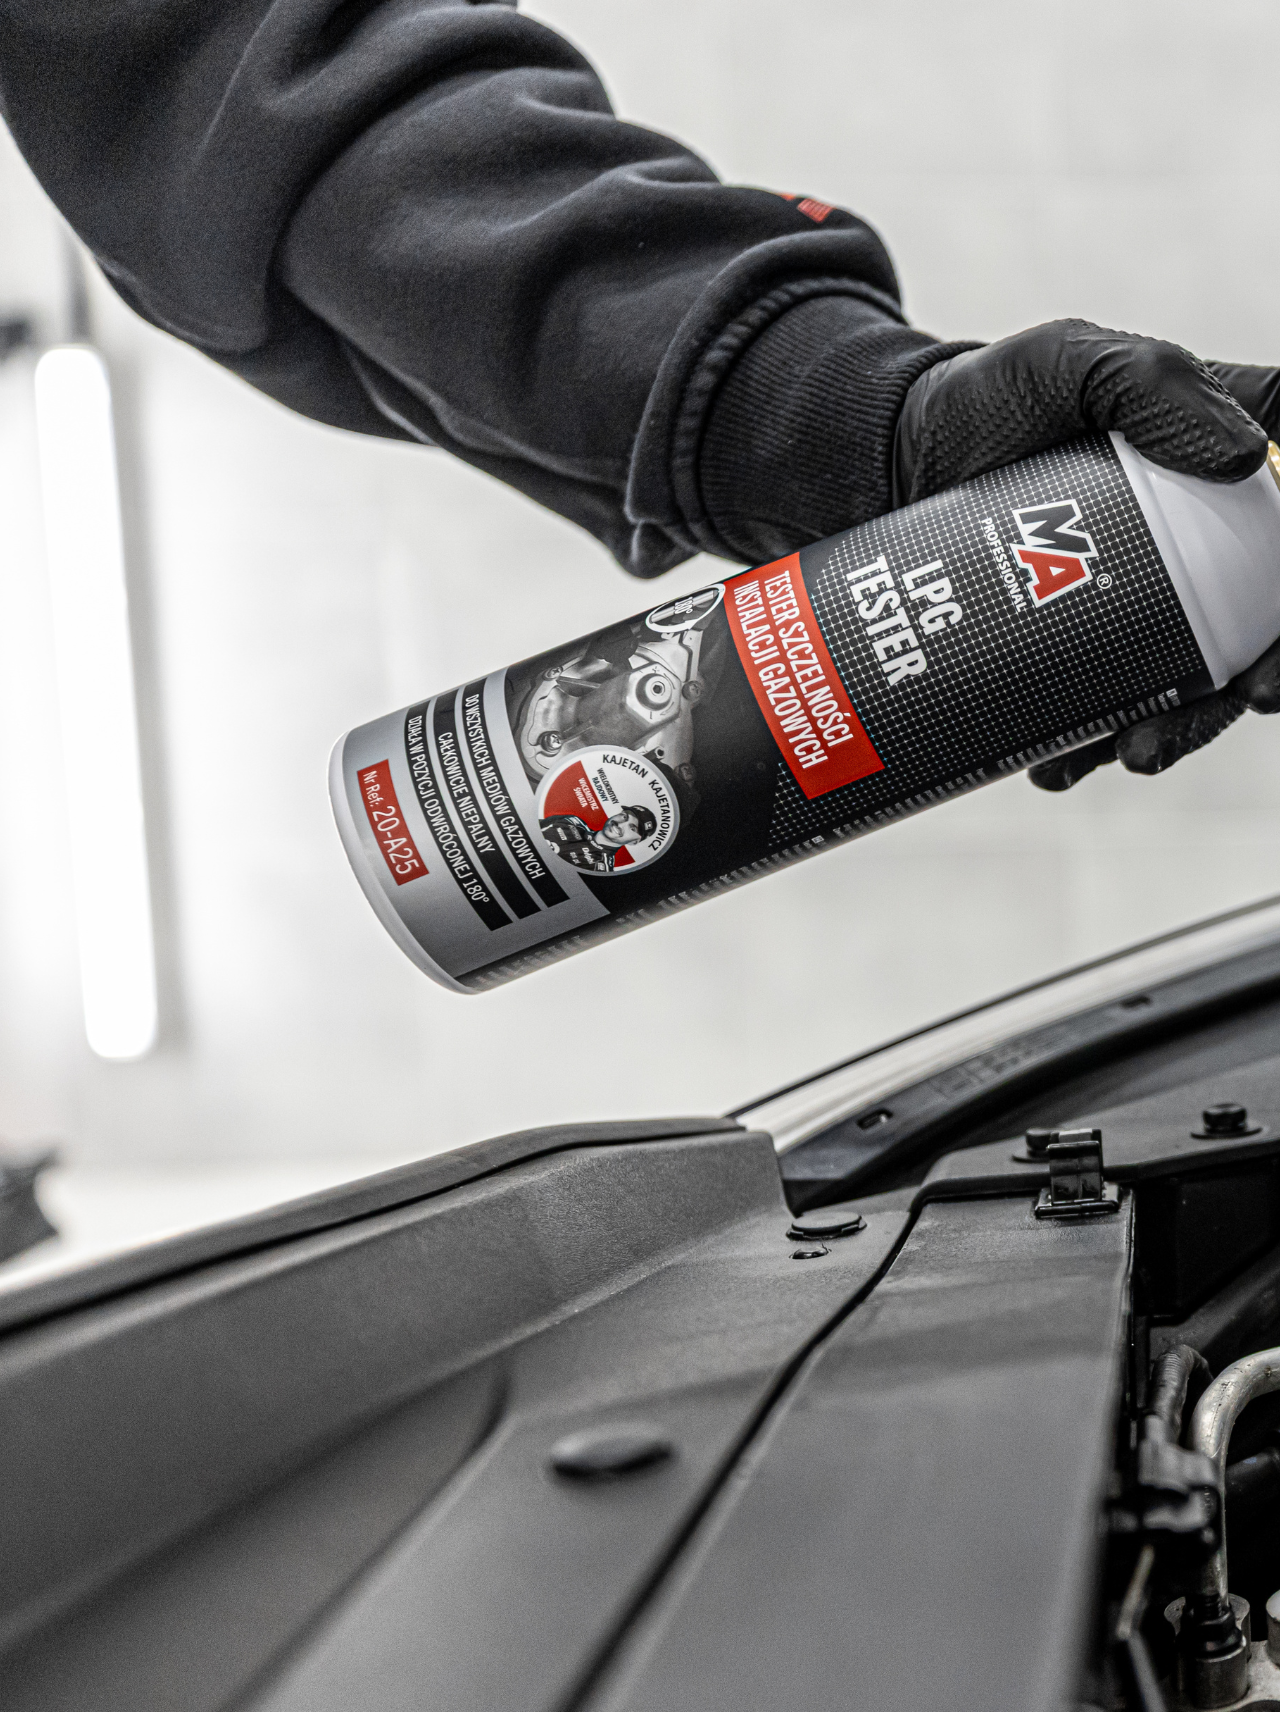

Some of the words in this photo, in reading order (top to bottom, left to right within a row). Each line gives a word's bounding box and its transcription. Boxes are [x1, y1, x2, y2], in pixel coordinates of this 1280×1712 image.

[982, 517, 1027, 612] PROFESSIONAL
[764, 570, 800, 625] TESTER
[846, 555, 927, 686] TESTER
[902, 559, 963, 635] LPG
[465, 694, 479, 708] DO
[734, 580, 780, 665] INSTALACJI
[759, 662, 828, 769] GAZOWYCH
[779, 621, 854, 747] SZCZELNOŚCI
[408, 715, 422, 744] DZIAŁA
[409, 743, 424, 755] W
[465, 708, 491, 771] WSZYSTKICH
[363, 770, 377, 784] Nr
[366, 783, 385, 808] Ref:
[411, 753, 436, 800] POZYCJI
[438, 731, 467, 798] CAŁKOWICIE
[456, 795, 496, 854] NIEPALNY
[480, 767, 512, 815] MEDIÓW
[602, 754, 649, 779] KAJETAN
[648, 779, 671, 852] KAJETANOWICZ
[372, 805, 420, 875] 20-A25
[424, 798, 469, 879] ODWRÓCONEJ
[500, 815, 546, 879] GAZOWYCH
[462, 878, 490, 903] 180°
